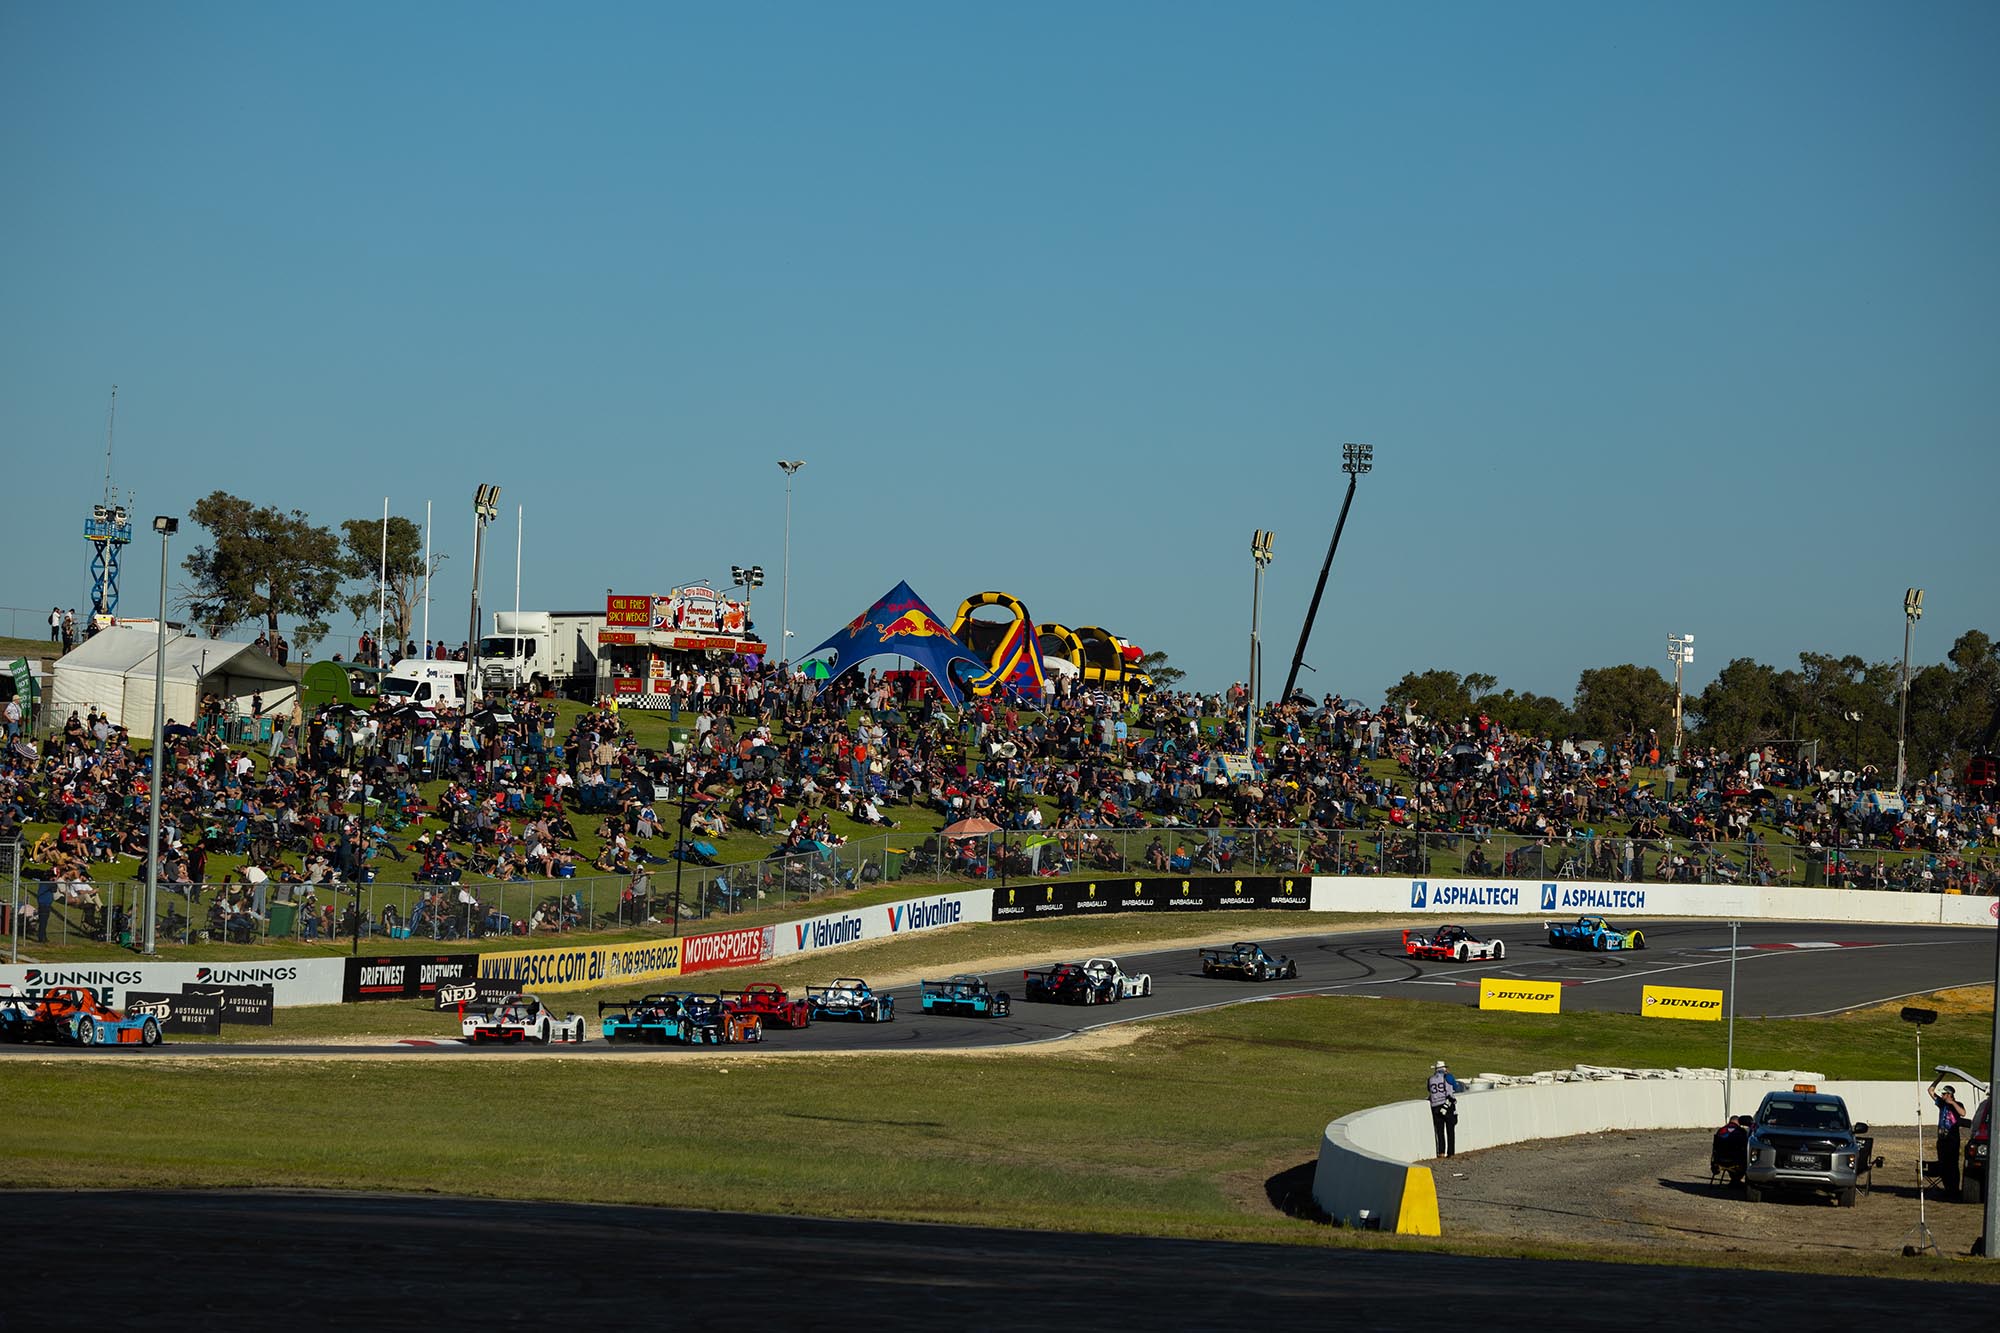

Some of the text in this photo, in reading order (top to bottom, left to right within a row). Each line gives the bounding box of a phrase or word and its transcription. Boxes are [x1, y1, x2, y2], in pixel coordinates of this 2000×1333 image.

[612, 600, 646, 609] CHILI FRIES
[609, 612, 648, 622] SPICY WEDGES
[1433, 886, 1519, 905] ASPHALTECH
[1562, 888, 1645, 908] ASPHALTECH
[1077, 900, 1107, 908] BARBAGALLO
[907, 898, 961, 929] Valvoline
[813, 915, 862, 948] Valvoline
[685, 930, 760, 964] MOTORSPORTS
[196, 968, 296, 983] BUNNINGS
[360, 965, 405, 985] DRIFTWEST
[420, 964, 463, 983] DRIFTWEST
[482, 952, 586, 985] wwwwascc.com
[24, 969, 142, 986] BUNNINGS
[229, 998, 267, 1006] AUSTRALIAN
[440, 987, 477, 1004] NED
[1497, 991, 1554, 1001] DUNLOP
[1659, 998, 1720, 1009] DUNLOP
[175, 1007, 215, 1015] AUSTRALIAN
[181, 1015, 207, 1023] WHISKY
[1431, 1083, 1446, 1094] 39
